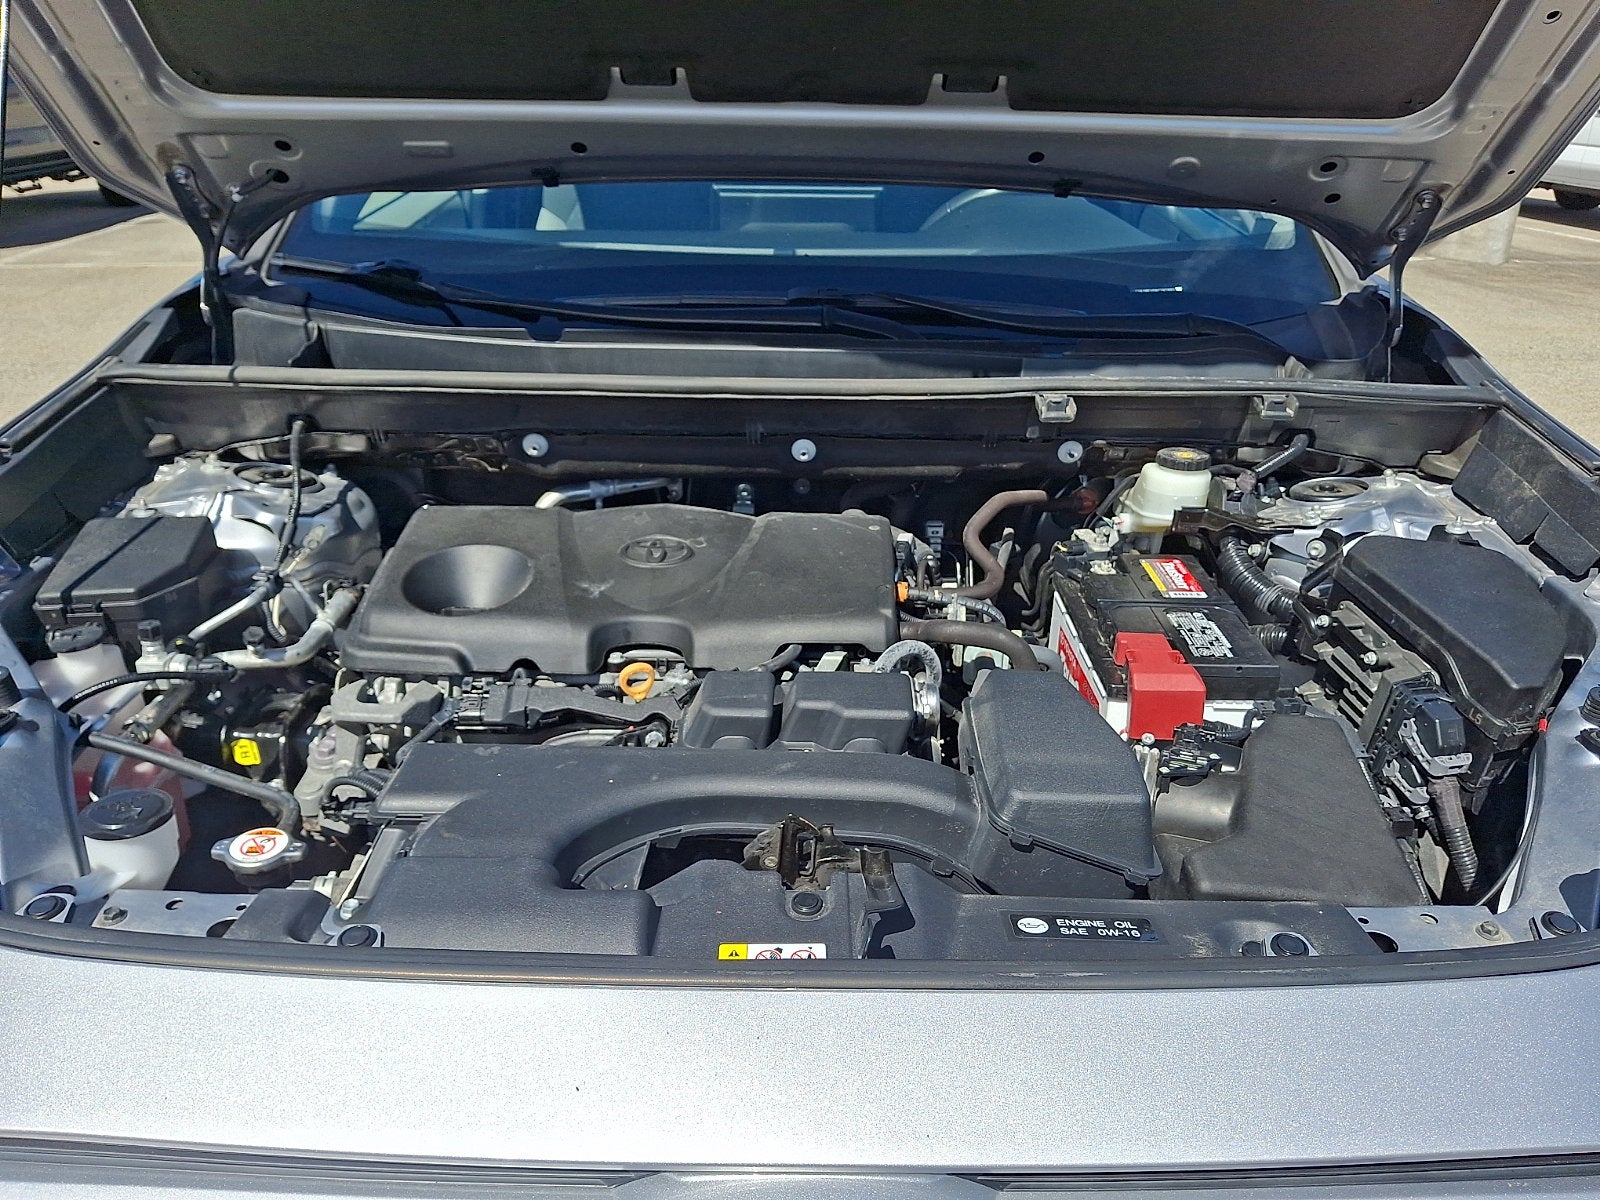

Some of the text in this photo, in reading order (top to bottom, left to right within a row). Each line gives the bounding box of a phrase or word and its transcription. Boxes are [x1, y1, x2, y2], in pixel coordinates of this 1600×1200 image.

[1469, 707, 1483, 725] L5
[1056, 918, 1137, 929] ENGINE OIL
[1060, 927, 1141, 938] SAE 0W-16
